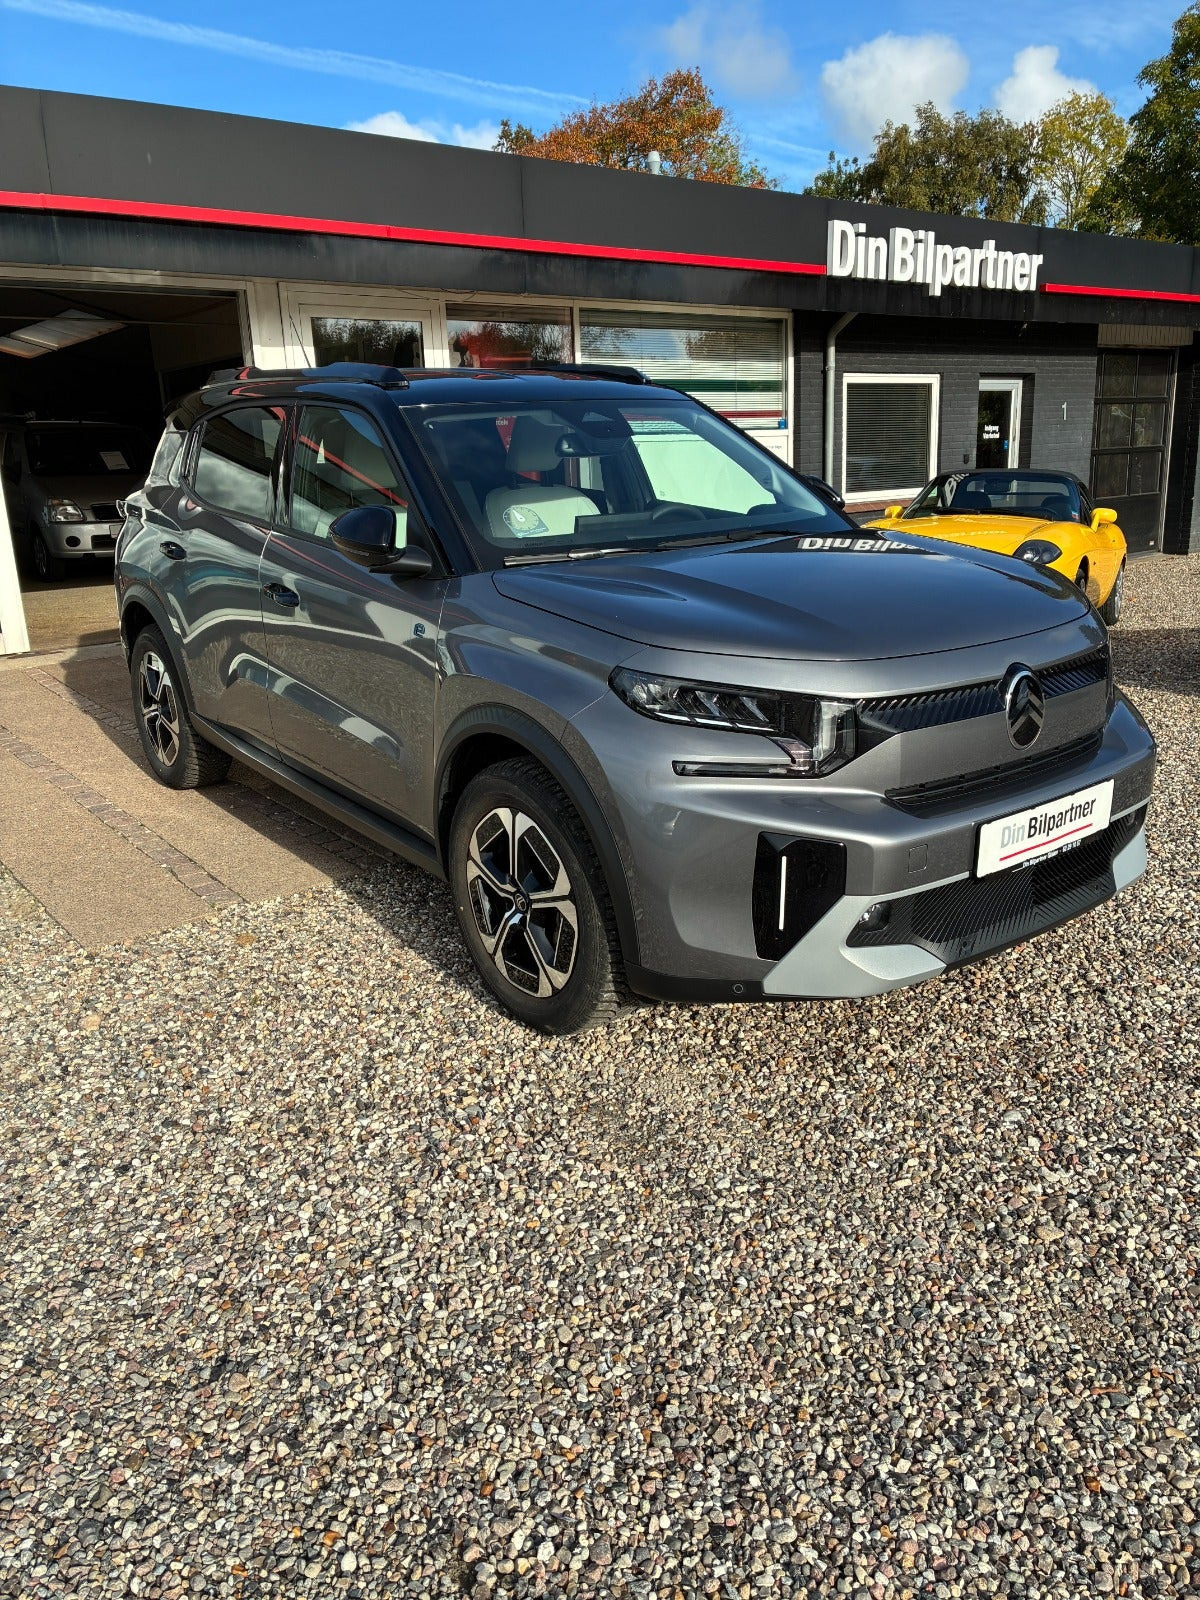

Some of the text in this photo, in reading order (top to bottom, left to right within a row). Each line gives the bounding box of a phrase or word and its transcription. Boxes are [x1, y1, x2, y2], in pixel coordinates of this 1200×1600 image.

[827, 219, 1044, 297] Din Bilpartner
[1062, 401, 1067, 420] 1
[1000, 823, 1026, 849] Din
[1027, 798, 1096, 839] Bilpartner
